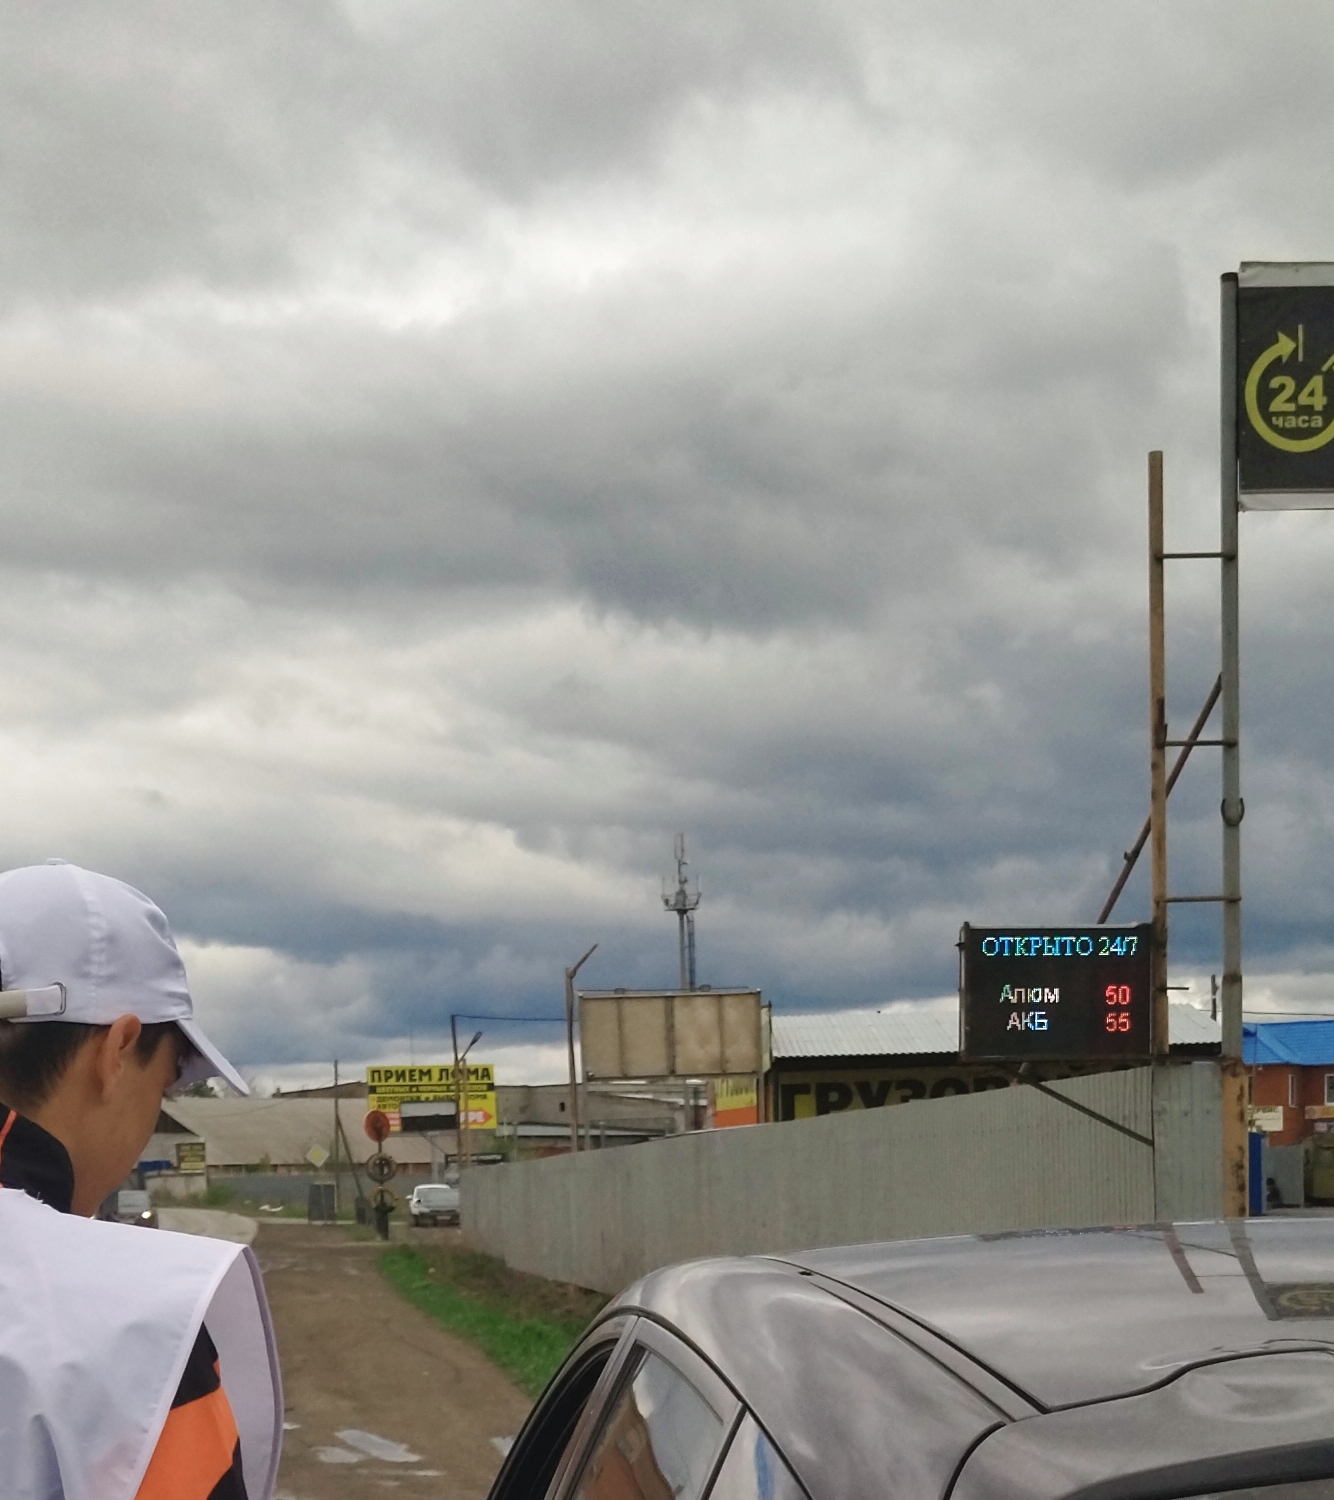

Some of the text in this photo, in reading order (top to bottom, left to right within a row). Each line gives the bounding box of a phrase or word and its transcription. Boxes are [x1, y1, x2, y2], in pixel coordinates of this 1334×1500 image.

[1268, 375, 1328, 412] 24
[1271, 415, 1324, 429] часа
[981, 936, 1094, 957] ОТКРЫТО
[999, 984, 1132, 1006] Алюм 50
[1006, 1011, 1049, 1031] АКБ
[370, 1068, 433, 1083] ПРИЕМ
